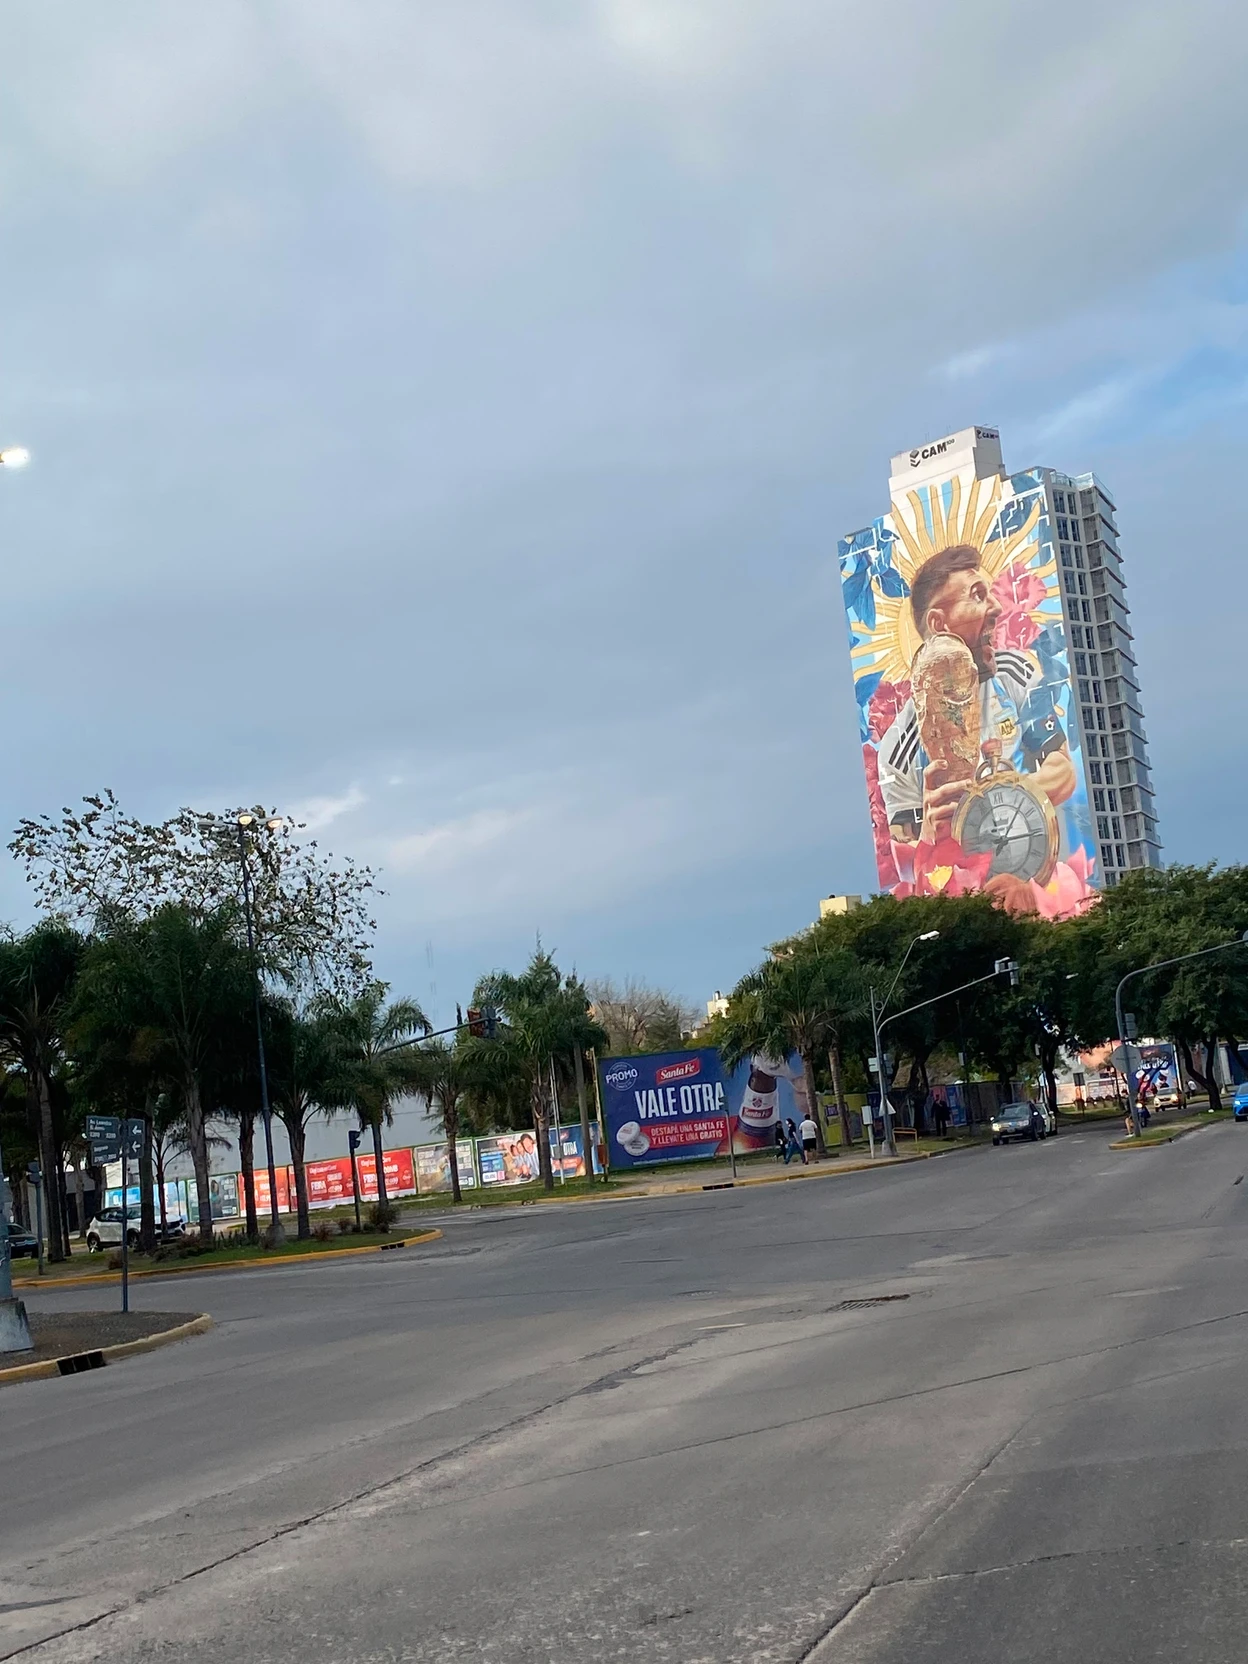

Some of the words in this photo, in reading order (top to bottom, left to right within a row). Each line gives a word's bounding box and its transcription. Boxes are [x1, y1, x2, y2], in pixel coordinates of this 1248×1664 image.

[922, 442, 947, 459] CAM
[605, 1068, 638, 1084] PROMO
[660, 1068, 684, 1080] Santa
[684, 1063, 695, 1074] Fe
[634, 1086, 678, 1119] VALE
[680, 1082, 725, 1115] OTRA
[680, 1123, 693, 1133] UNA
[694, 1121, 715, 1132] SANTA
[716, 1120, 725, 1129] FE
[652, 1137, 658, 1145] Y
[685, 1132, 699, 1142] UNA
[699, 1129, 723, 1140] GRATIS
